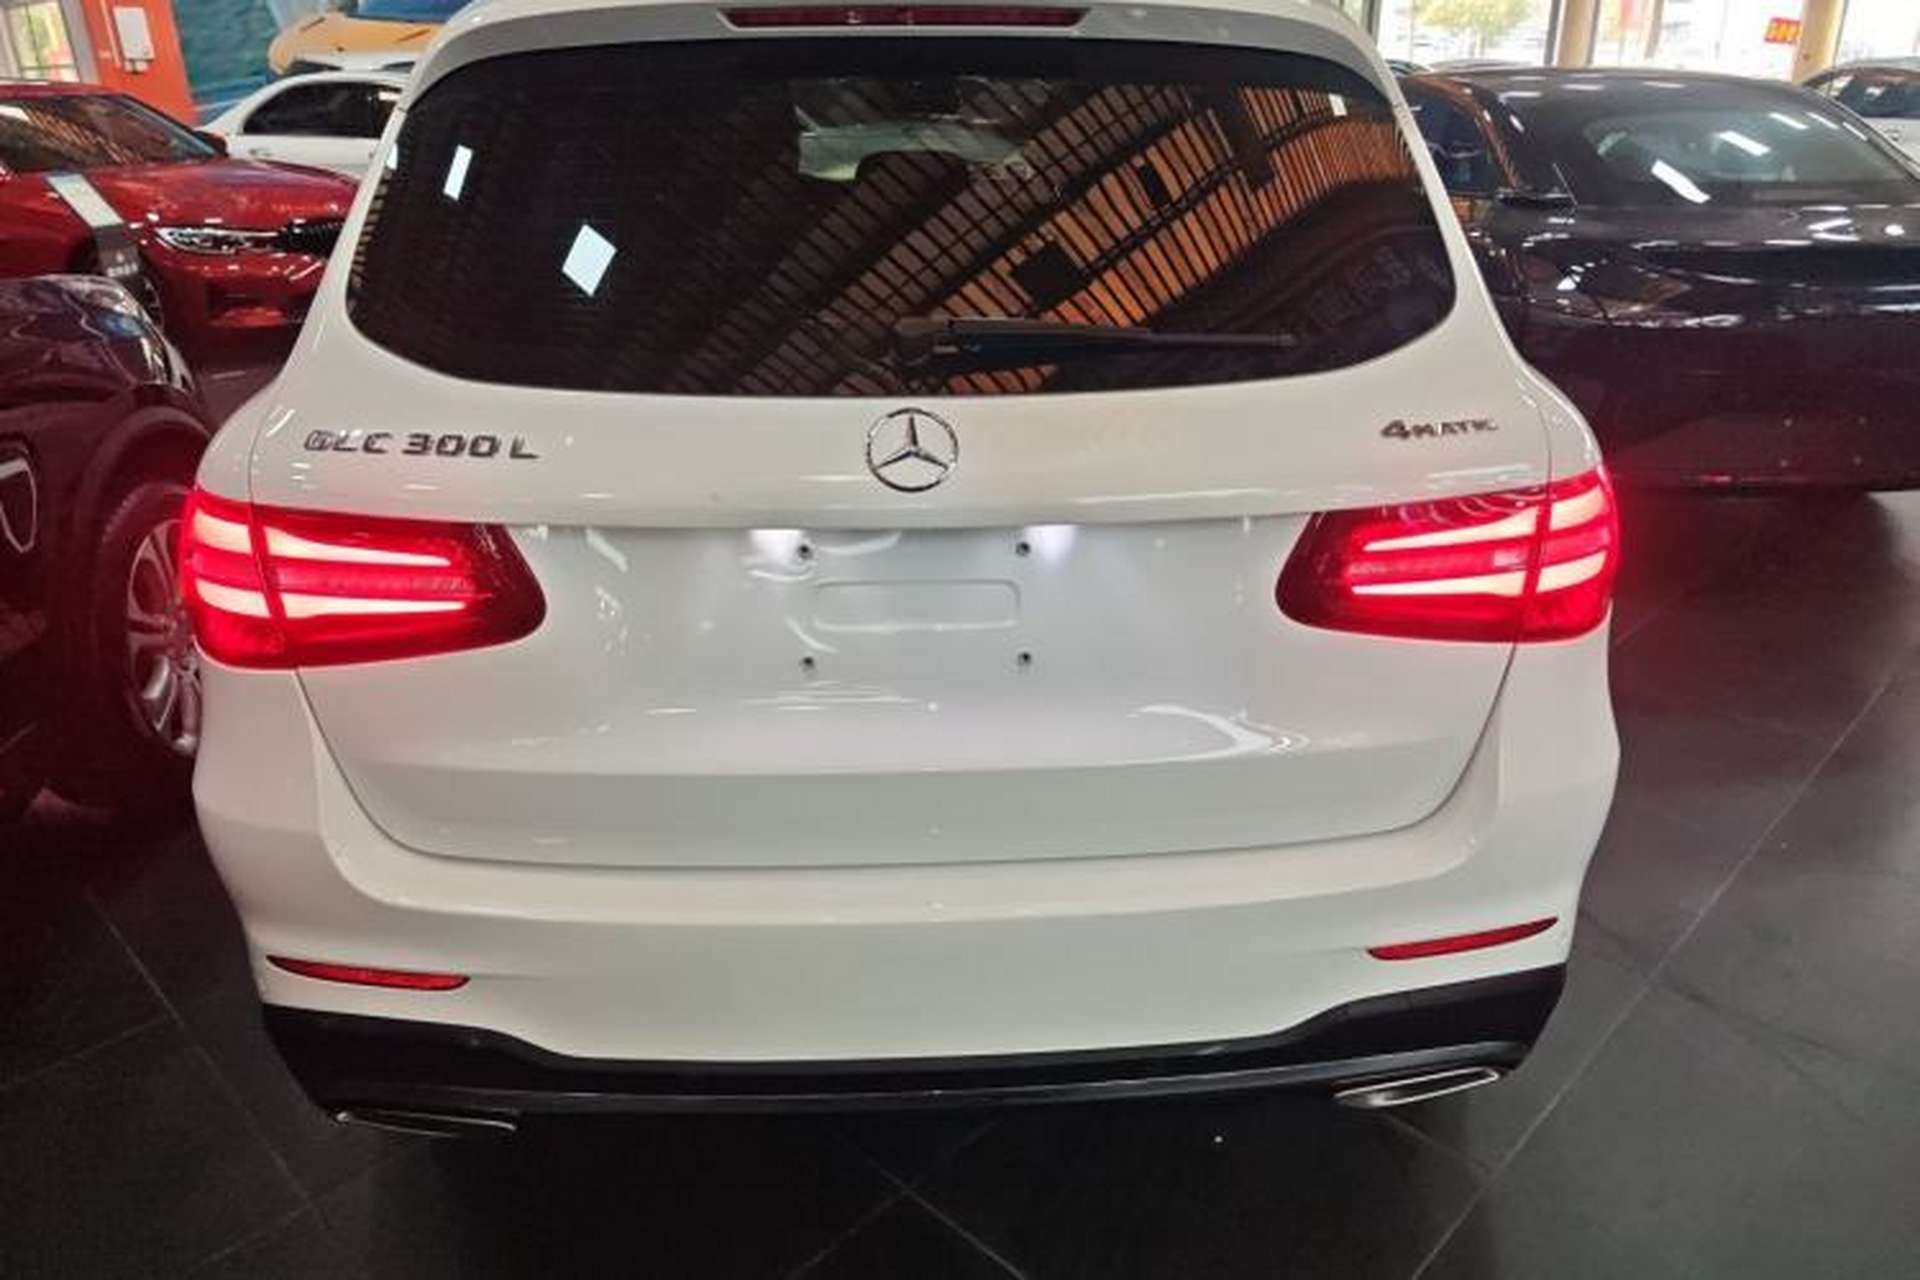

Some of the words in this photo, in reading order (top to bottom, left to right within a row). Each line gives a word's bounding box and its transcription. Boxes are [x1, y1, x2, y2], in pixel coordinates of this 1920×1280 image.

[1380, 419, 1498, 439] 4MATIC
[303, 429, 394, 455] GLC
[401, 432, 502, 457] 300
[509, 436, 541, 460] L
